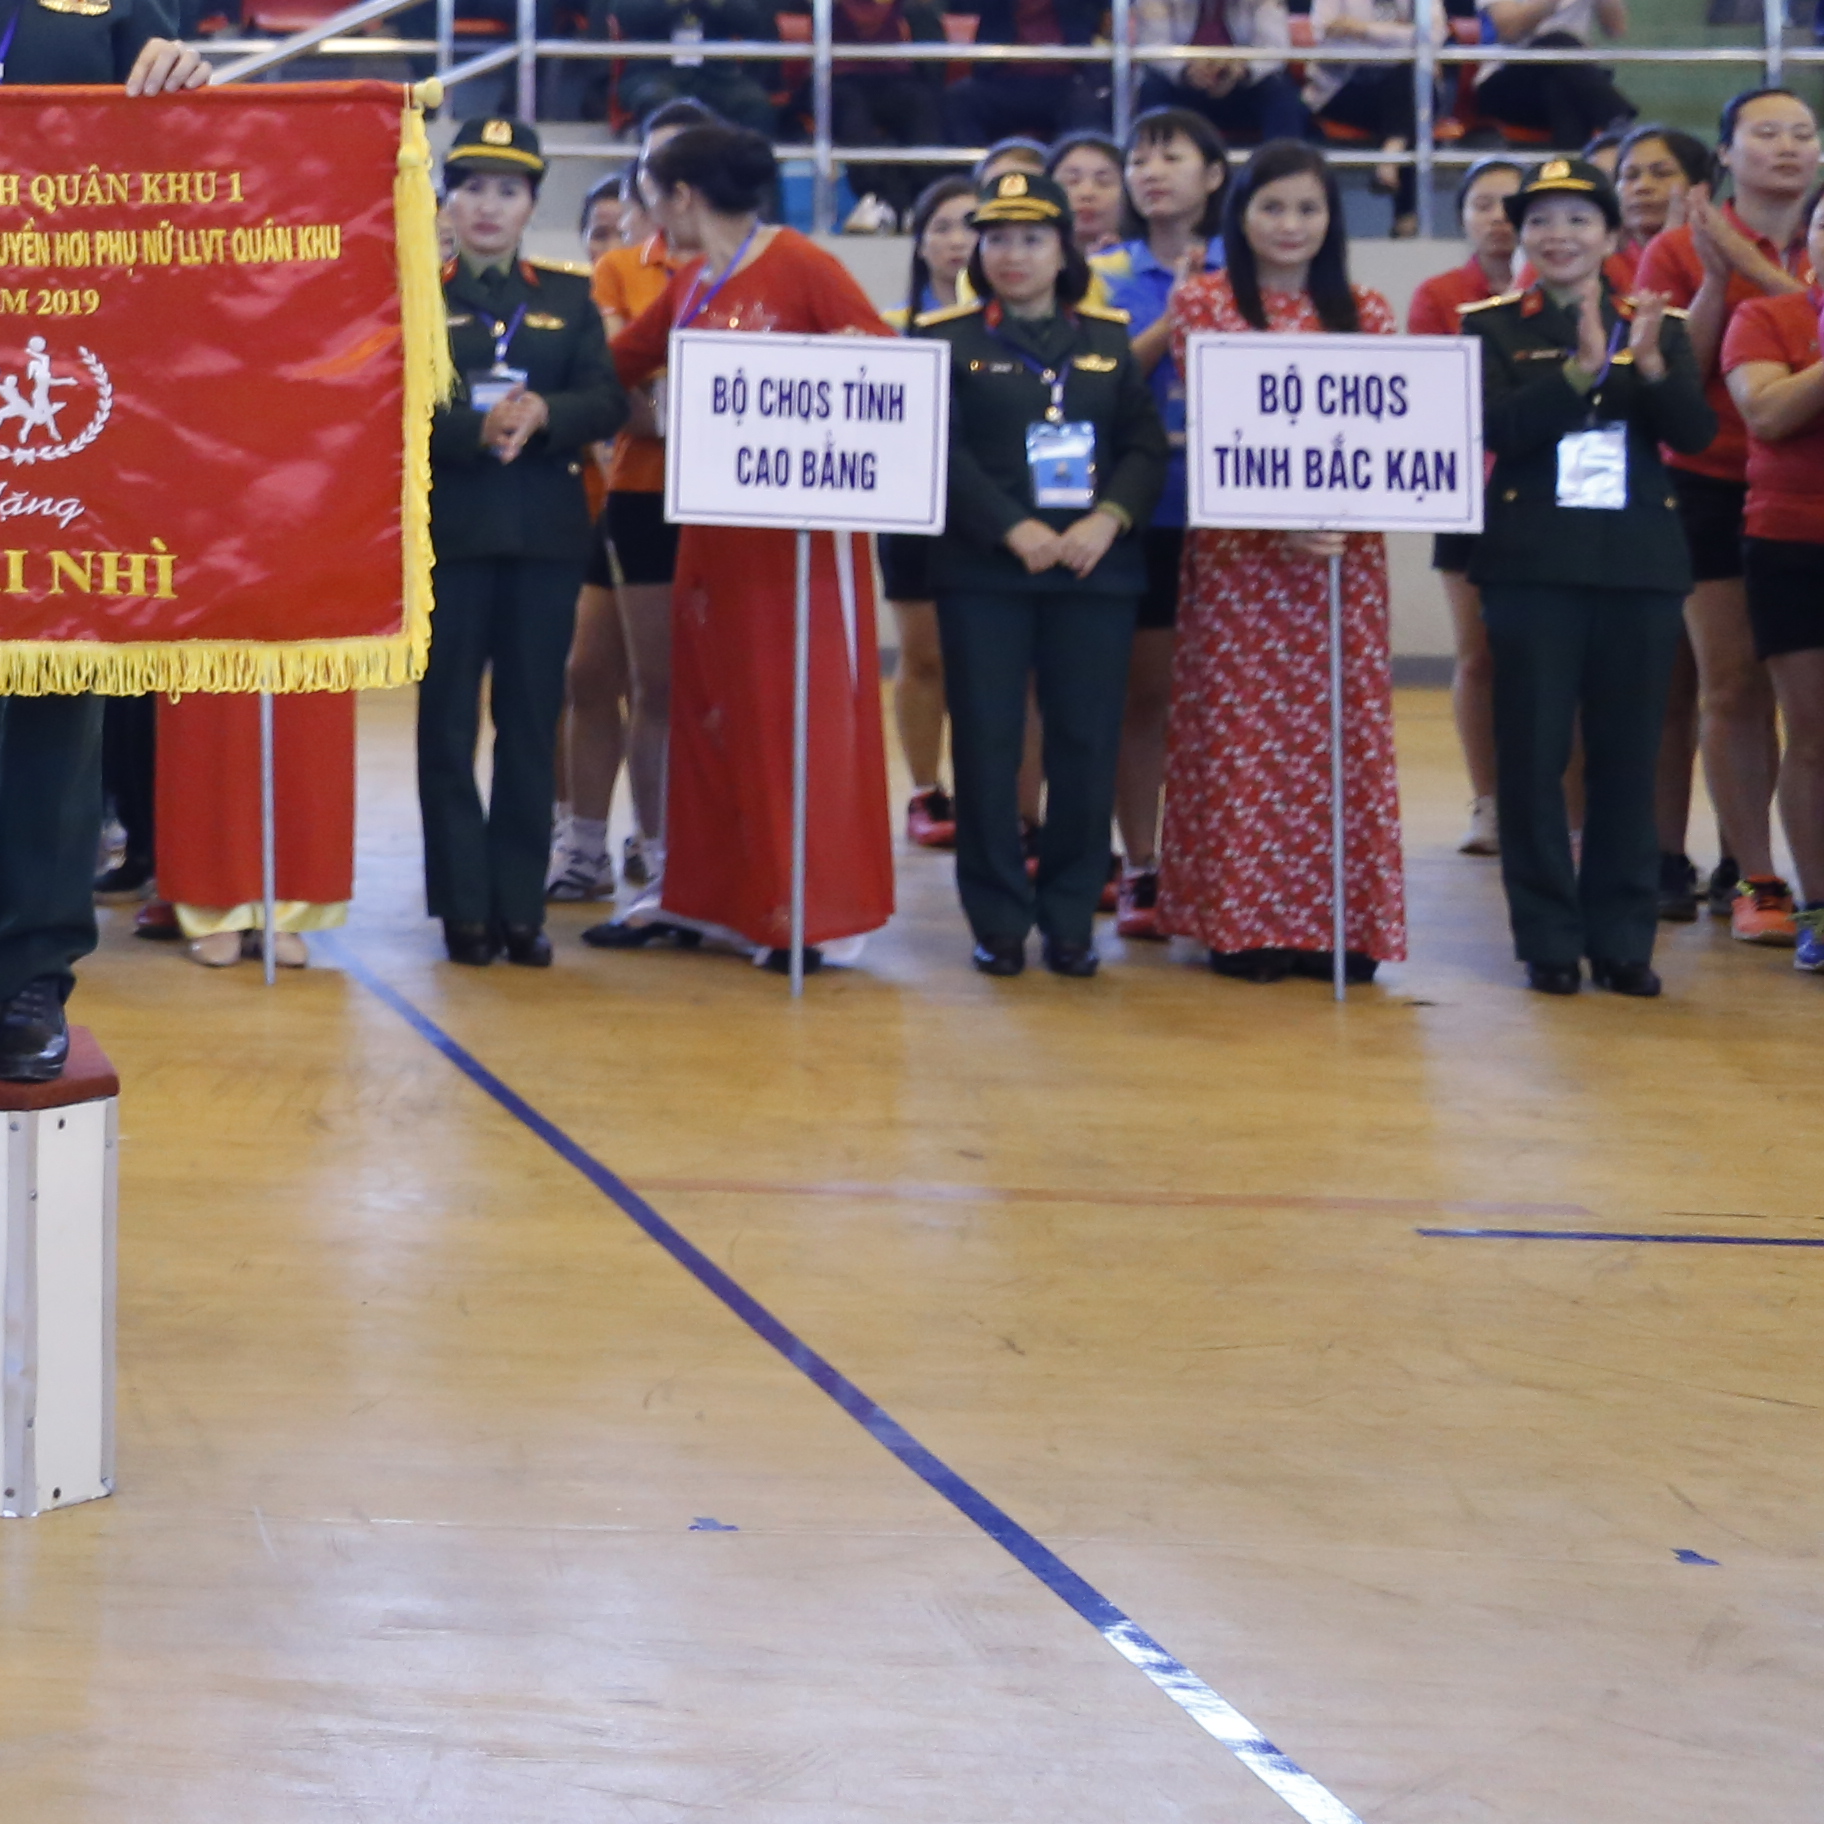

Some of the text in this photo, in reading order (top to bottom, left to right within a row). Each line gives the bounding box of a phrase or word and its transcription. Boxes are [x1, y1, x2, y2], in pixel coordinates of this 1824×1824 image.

[30, 170, 129, 206] QUÂN
[140, 173, 218, 205] KHU
[228, 172, 244, 203] 1
[56, 229, 90, 265] HƠI
[95, 230, 137, 277] PHỤ
[143, 219, 176, 265] NỮ
[180, 229, 224, 265] LLVT
[232, 219, 293, 265] QUÂN
[297, 223, 341, 261] KHU
[37, 288, 100, 316] 2019
[712, 365, 904, 426] BỘ CHQS TỈNH
[1259, 365, 1409, 424] BỘ CHQS
[736, 446, 790, 489] CAO
[1213, 436, 1457, 503] TỈNH BẮC KẠN
[50, 538, 178, 599] NHÌ
